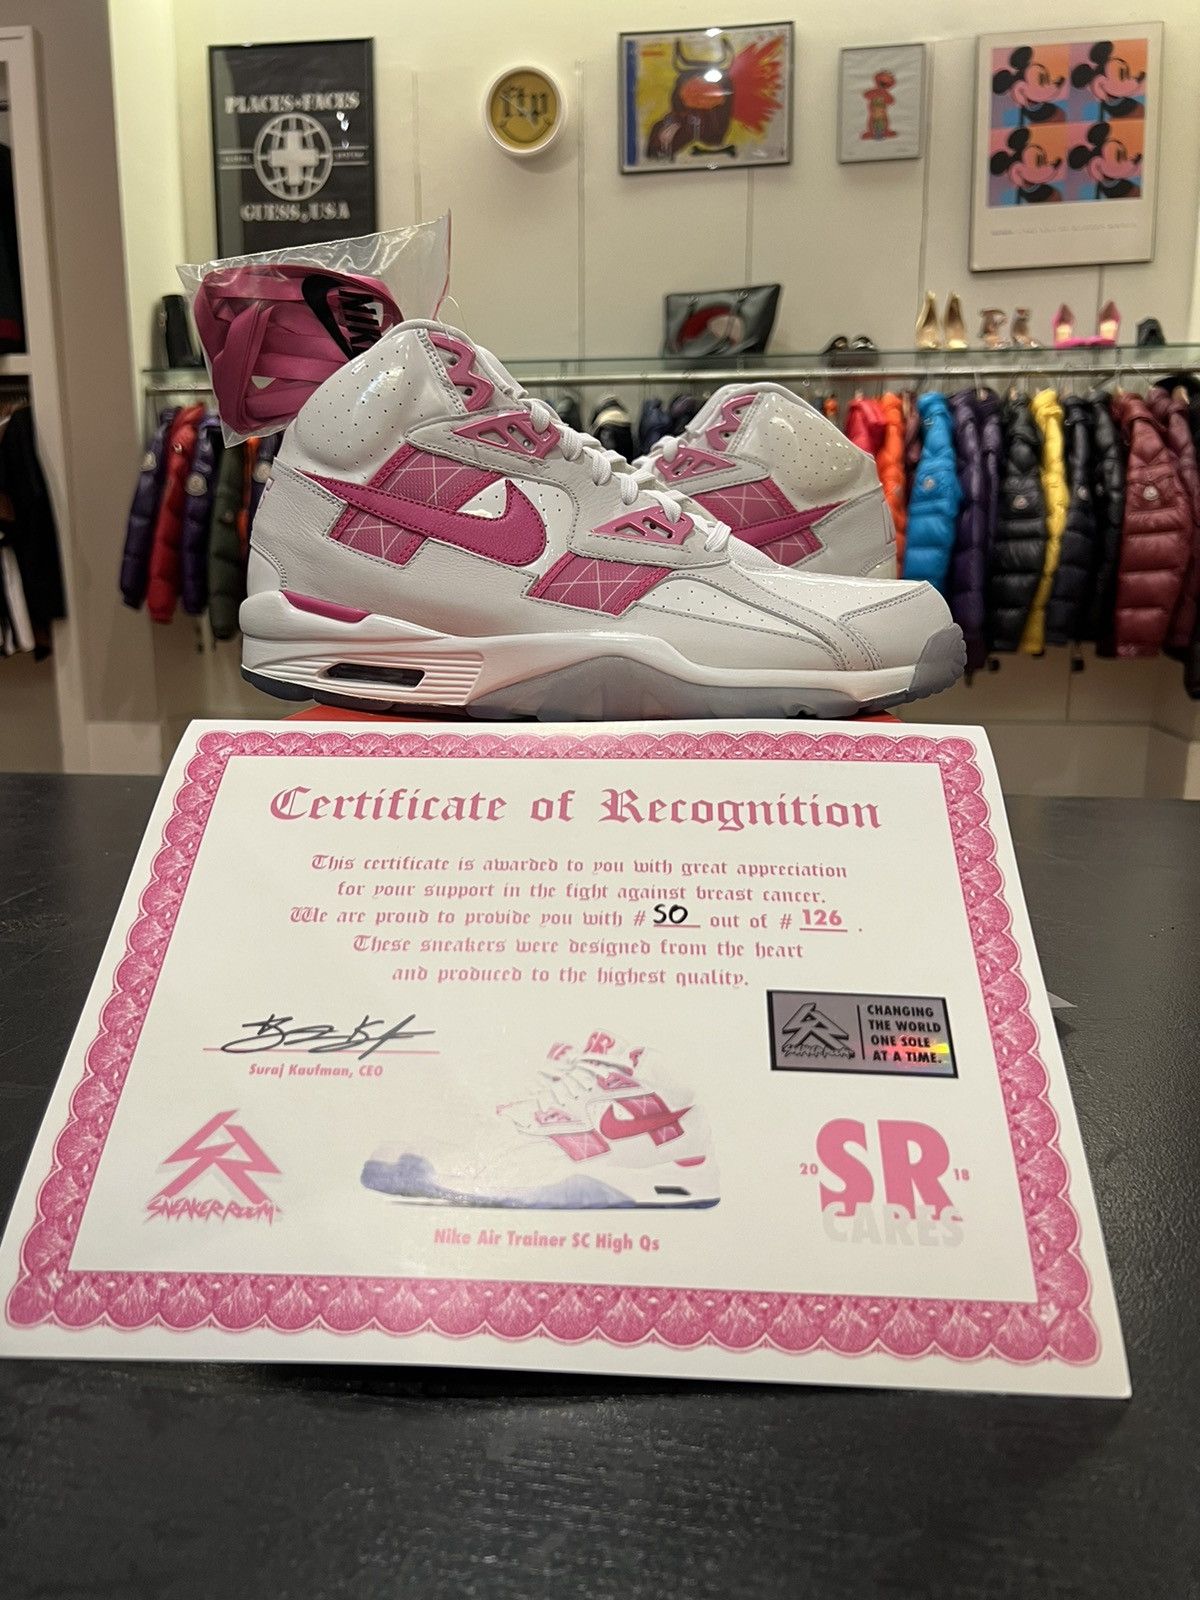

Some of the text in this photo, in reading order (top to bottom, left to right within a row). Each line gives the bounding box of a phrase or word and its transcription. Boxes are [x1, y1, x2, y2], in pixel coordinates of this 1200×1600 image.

[270, 785, 883, 832] Certificate of Recognition
[311, 854, 848, 879] This certificate is awarded to you with great appreciation
[337, 880, 827, 904] for your support in the fight against breast cancer.
[289, 906, 328, 923] We
[336, 909, 366, 923] are
[375, 908, 429, 926] proud
[437, 909, 455, 924] to
[464, 909, 531, 926] provide
[538, 912, 572, 928] you
[583, 911, 622, 927] with
[633, 911, 646, 926] #
[710, 914, 740, 928] out
[750, 913, 768, 929] of
[780, 913, 792, 930] #
[802, 908, 842, 927] 126
[353, 934, 804, 958] These sneakers were designed from the heart
[392, 965, 749, 987] and produced to the highest quality.
[867, 1004, 934, 1018] CHANGING
[868, 1019, 942, 1033] THE WORLD
[871, 1034, 931, 1048] ONE SOLE
[873, 1050, 942, 1064] AT A TIME.
[249, 1063, 384, 1079] Suraj Kaufman, CEO
[799, 1117, 970, 1218] 20 SR 18
[822, 1201, 964, 1248] CARES
[433, 1228, 661, 1254] Nike Air Trainer SC High Qs
